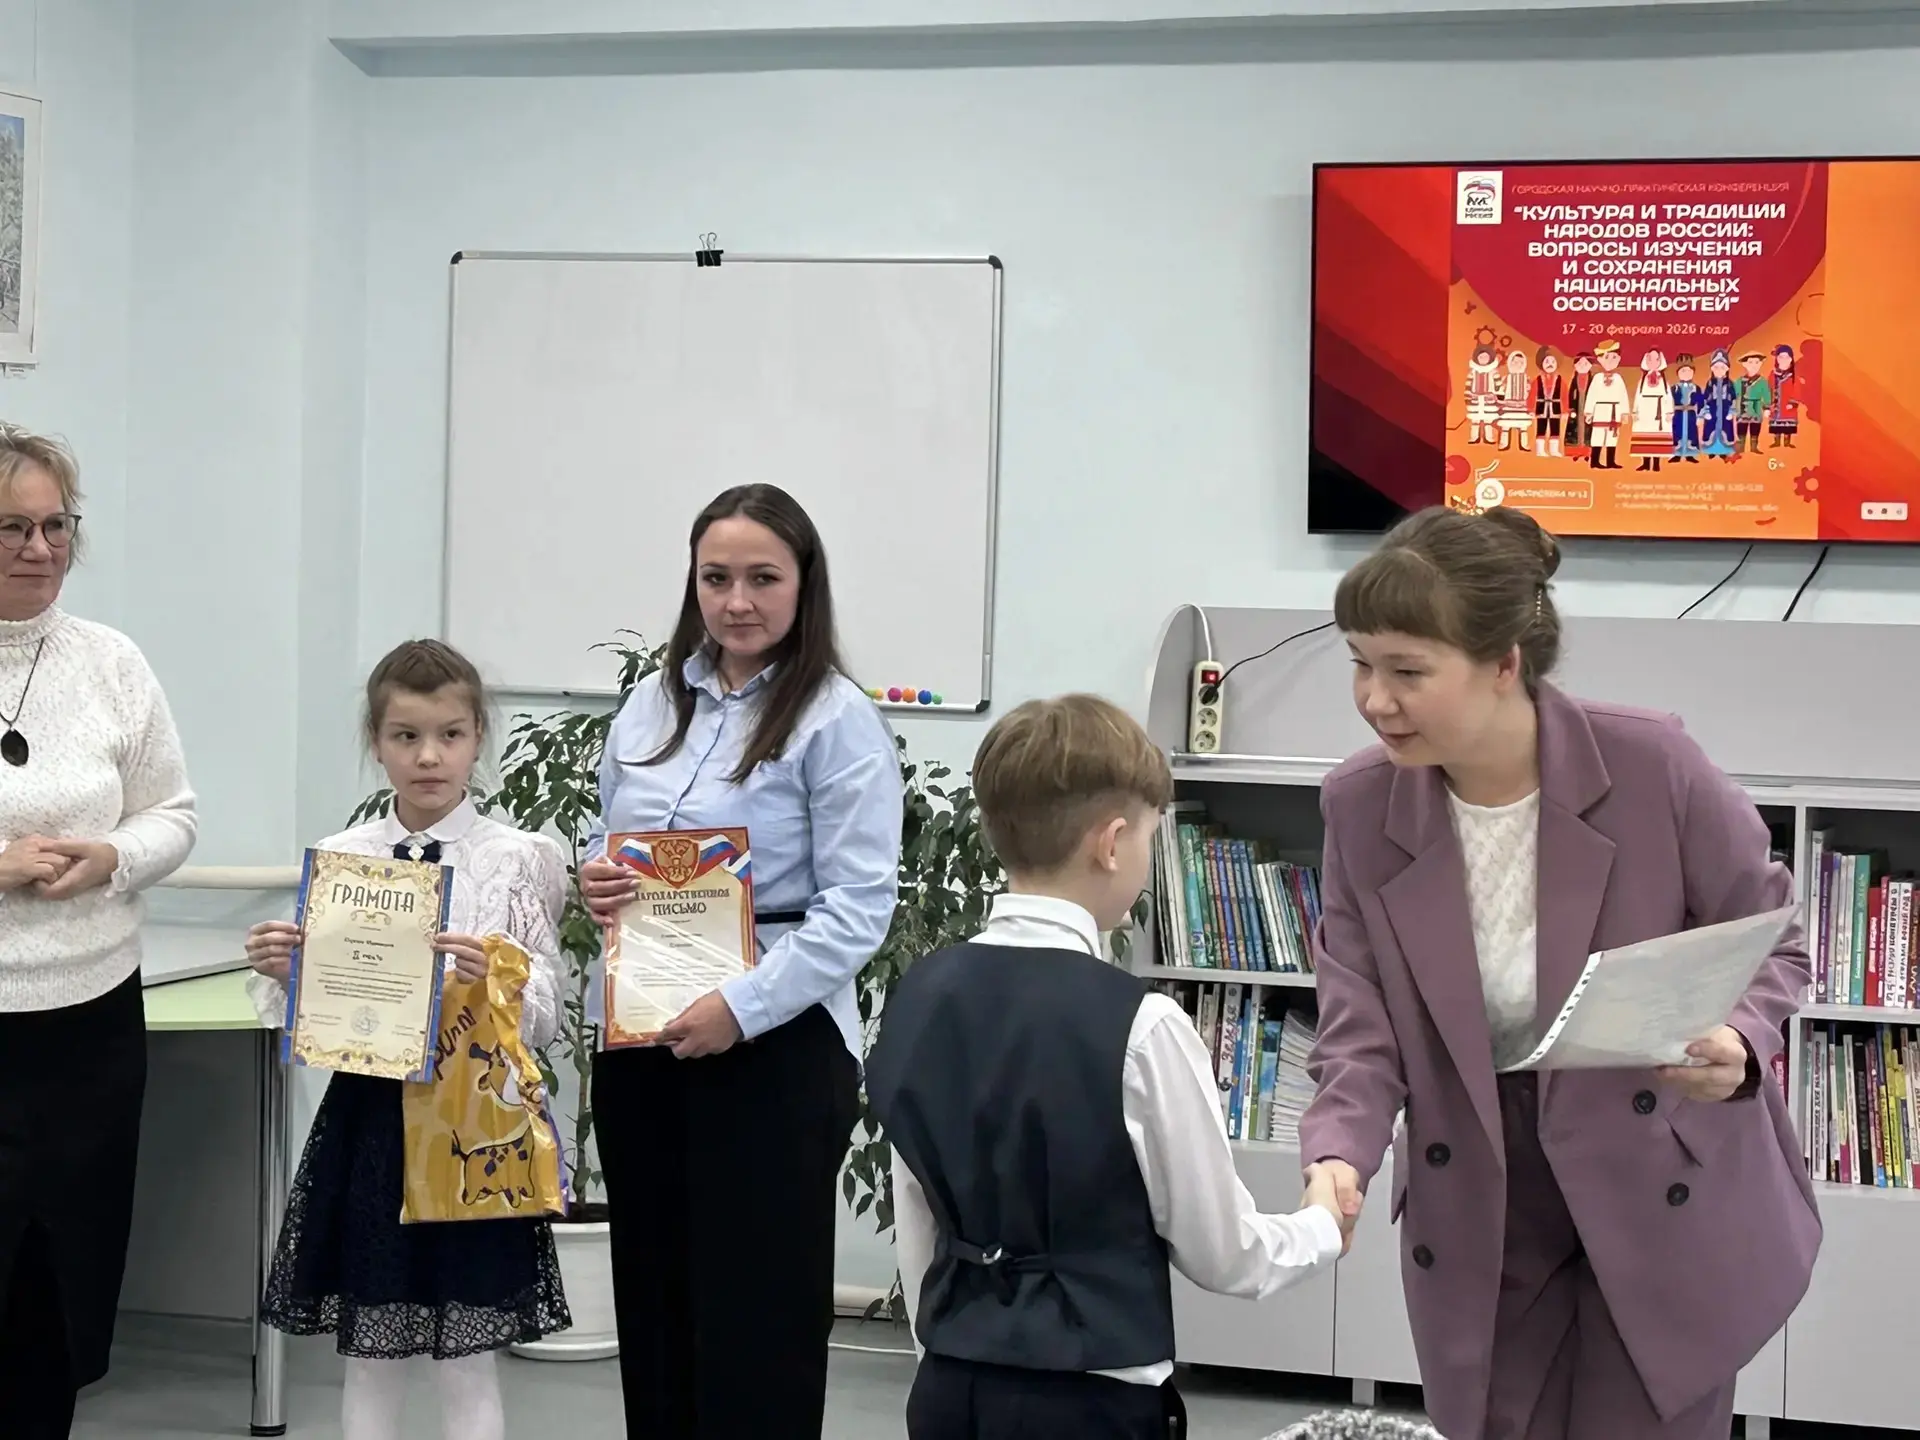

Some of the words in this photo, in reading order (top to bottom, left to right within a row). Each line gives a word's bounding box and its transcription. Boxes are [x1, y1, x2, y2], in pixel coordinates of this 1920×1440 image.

[1640, 204, 1657, 220] И
[1662, 203, 1786, 219] ТРАДИЦИИ
[1544, 223, 1650, 238] НАРОДОВ
[1656, 222, 1754, 238] РОССИИ:
[1528, 241, 1638, 257] ВОПРОСЫ
[1643, 240, 1762, 256] ИЗУЧЕНИЯ
[1562, 260, 1578, 275] И
[1584, 259, 1733, 275] СОХРАНЕНИЯ
[1554, 277, 1741, 293] НАЦИОНАЛЬНЫХ
[1562, 323, 1576, 335] 17
[1589, 323, 1603, 335] 20
[1606, 322, 1664, 337] февраля
[1666, 323, 1697, 335] 2026
[1700, 324, 1731, 336] года
[1768, 457, 1786, 471] 6+
[332, 883, 415, 913] ГРАМОТА
[653, 902, 707, 916] ПИСЬМО
